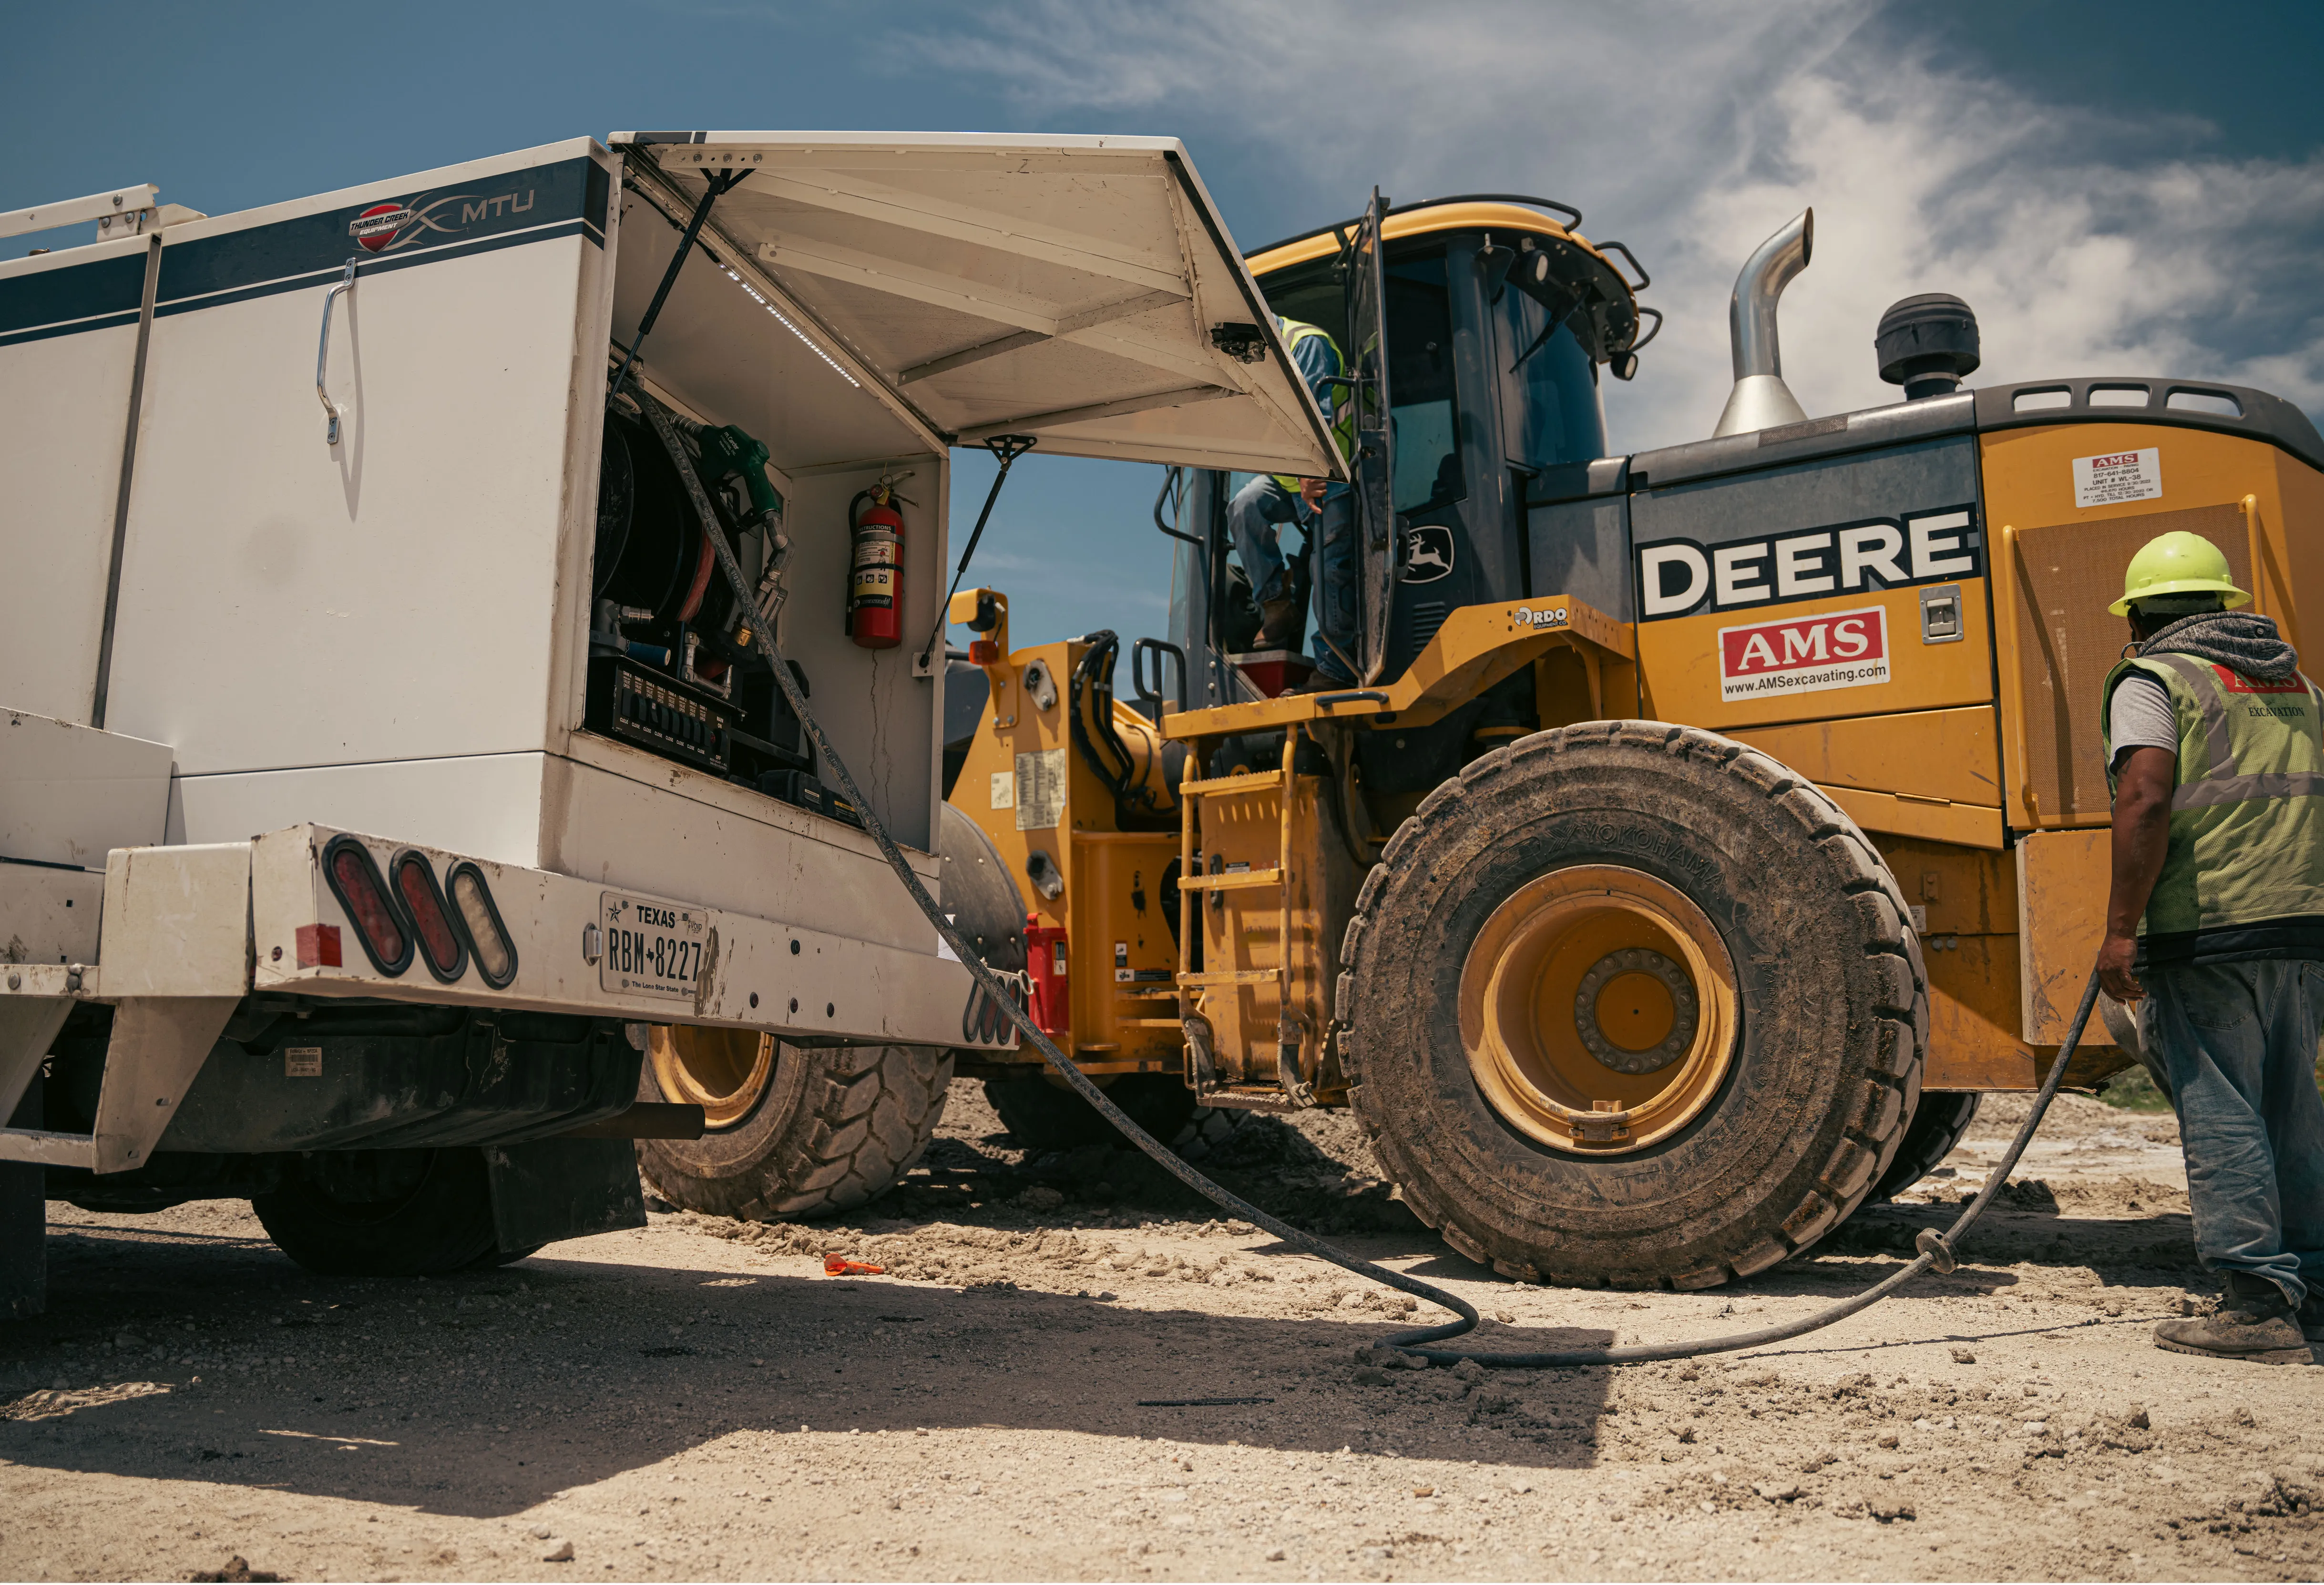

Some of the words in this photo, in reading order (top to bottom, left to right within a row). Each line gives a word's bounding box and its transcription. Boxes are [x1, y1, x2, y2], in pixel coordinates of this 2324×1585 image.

[462, 189, 534, 224] MTU
[351, 217, 384, 230] THUNDER
[385, 211, 410, 223] CREEK
[359, 222, 398, 235] EQUIPMENT
[727, 436, 739, 450] Carder
[2096, 454, 2135, 467] AMS
[2093, 468, 2139, 479] 817-641-8804
[2118, 474, 2141, 482] WL-38
[1641, 511, 1973, 615] DEERE
[1534, 621, 1558, 629] EQUIPMENT
[1737, 619, 1869, 671] AMS
[1724, 665, 1887, 695] www.AMSexcavating.com
[2248, 707, 2305, 717] EXCAVATION
[830, 758, 845, 777] TRITON
[843, 777, 853, 791] Push
[851, 792, 861, 805] Lock
[860, 806, 870, 816] 3/4"
[1582, 823, 1727, 896] YOKOHAMA
[637, 905, 676, 929] TEXAS
[690, 922, 702, 930] VOID
[609, 927, 644, 974] RBM
[655, 936, 701, 982] 8227
[1761, 960, 1779, 1031] RADIAL
